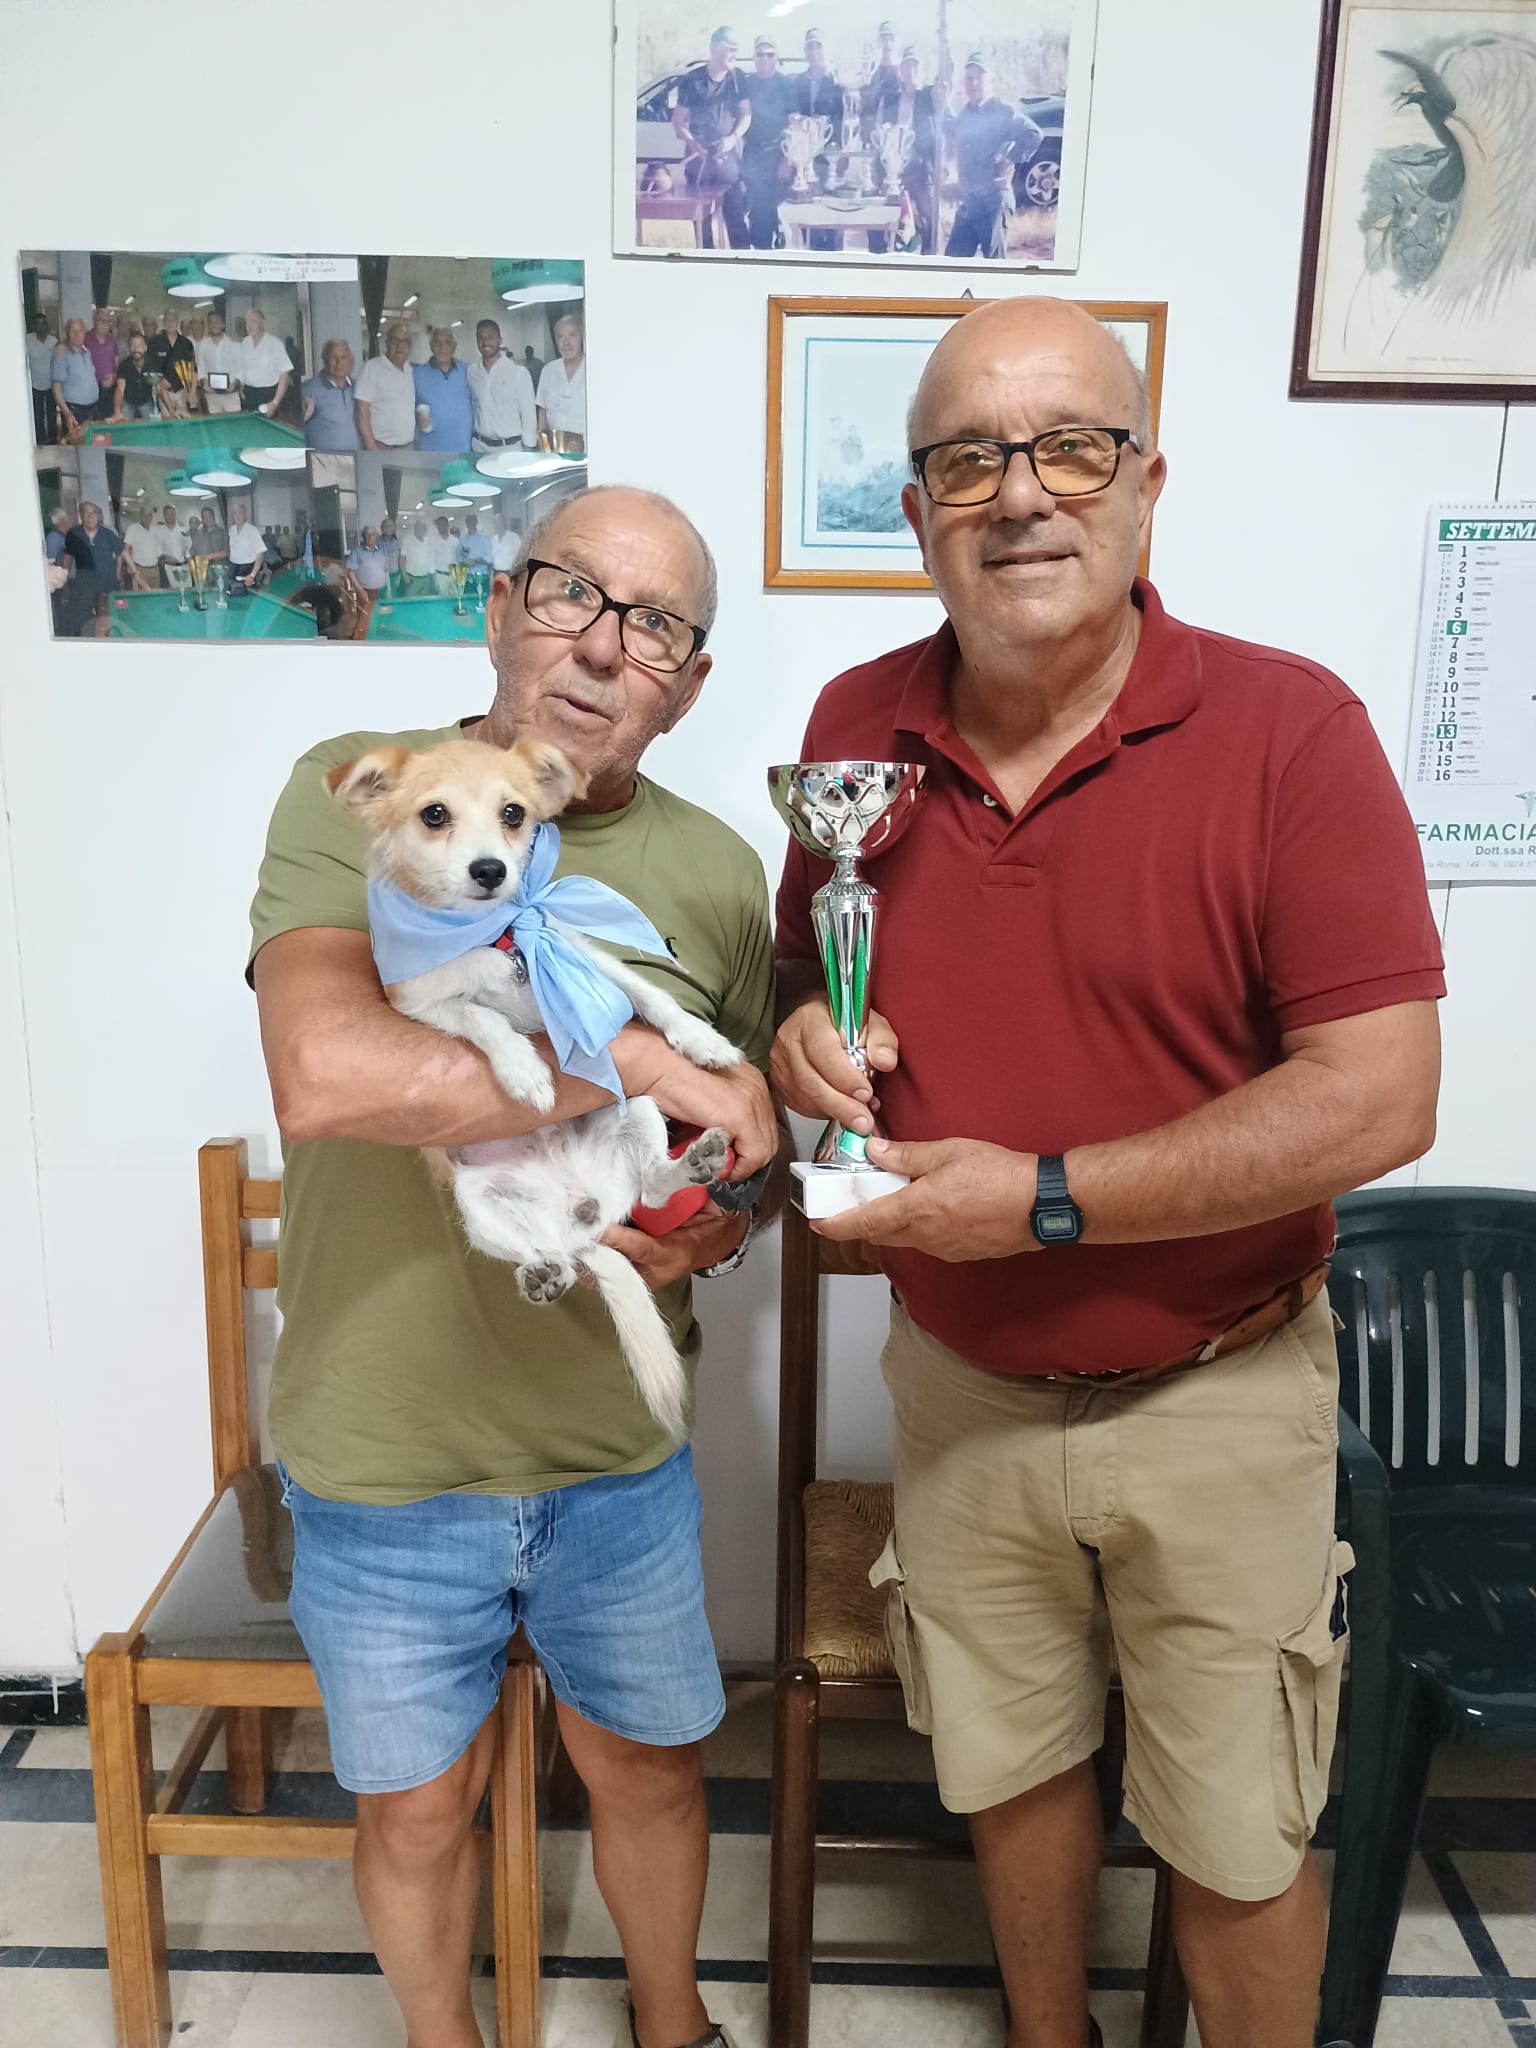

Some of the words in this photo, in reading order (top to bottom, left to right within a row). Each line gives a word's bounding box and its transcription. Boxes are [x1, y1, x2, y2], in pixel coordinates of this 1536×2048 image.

[1461, 546, 1467, 558] 1
[1459, 561, 1467, 573] 2
[1457, 576, 1466, 588] 3
[1455, 592, 1464, 604] 4
[1453, 607, 1462, 619] 5
[1451, 621, 1462, 634] 6
[1451, 637, 1459, 649] 7
[1449, 652, 1457, 664] 8
[1448, 667, 1456, 679] 9
[1442, 682, 1459, 693] 10
[1441, 697, 1456, 708] 11
[1440, 711, 1456, 723] 12
[1438, 725, 1455, 738] 13
[1438, 740, 1453, 752] 14
[1436, 755, 1452, 767] 15
[1435, 769, 1451, 781] 16
[1415, 823, 1536, 841] FARMACIA
[1475, 845, 1524, 856] Dott.ssa
